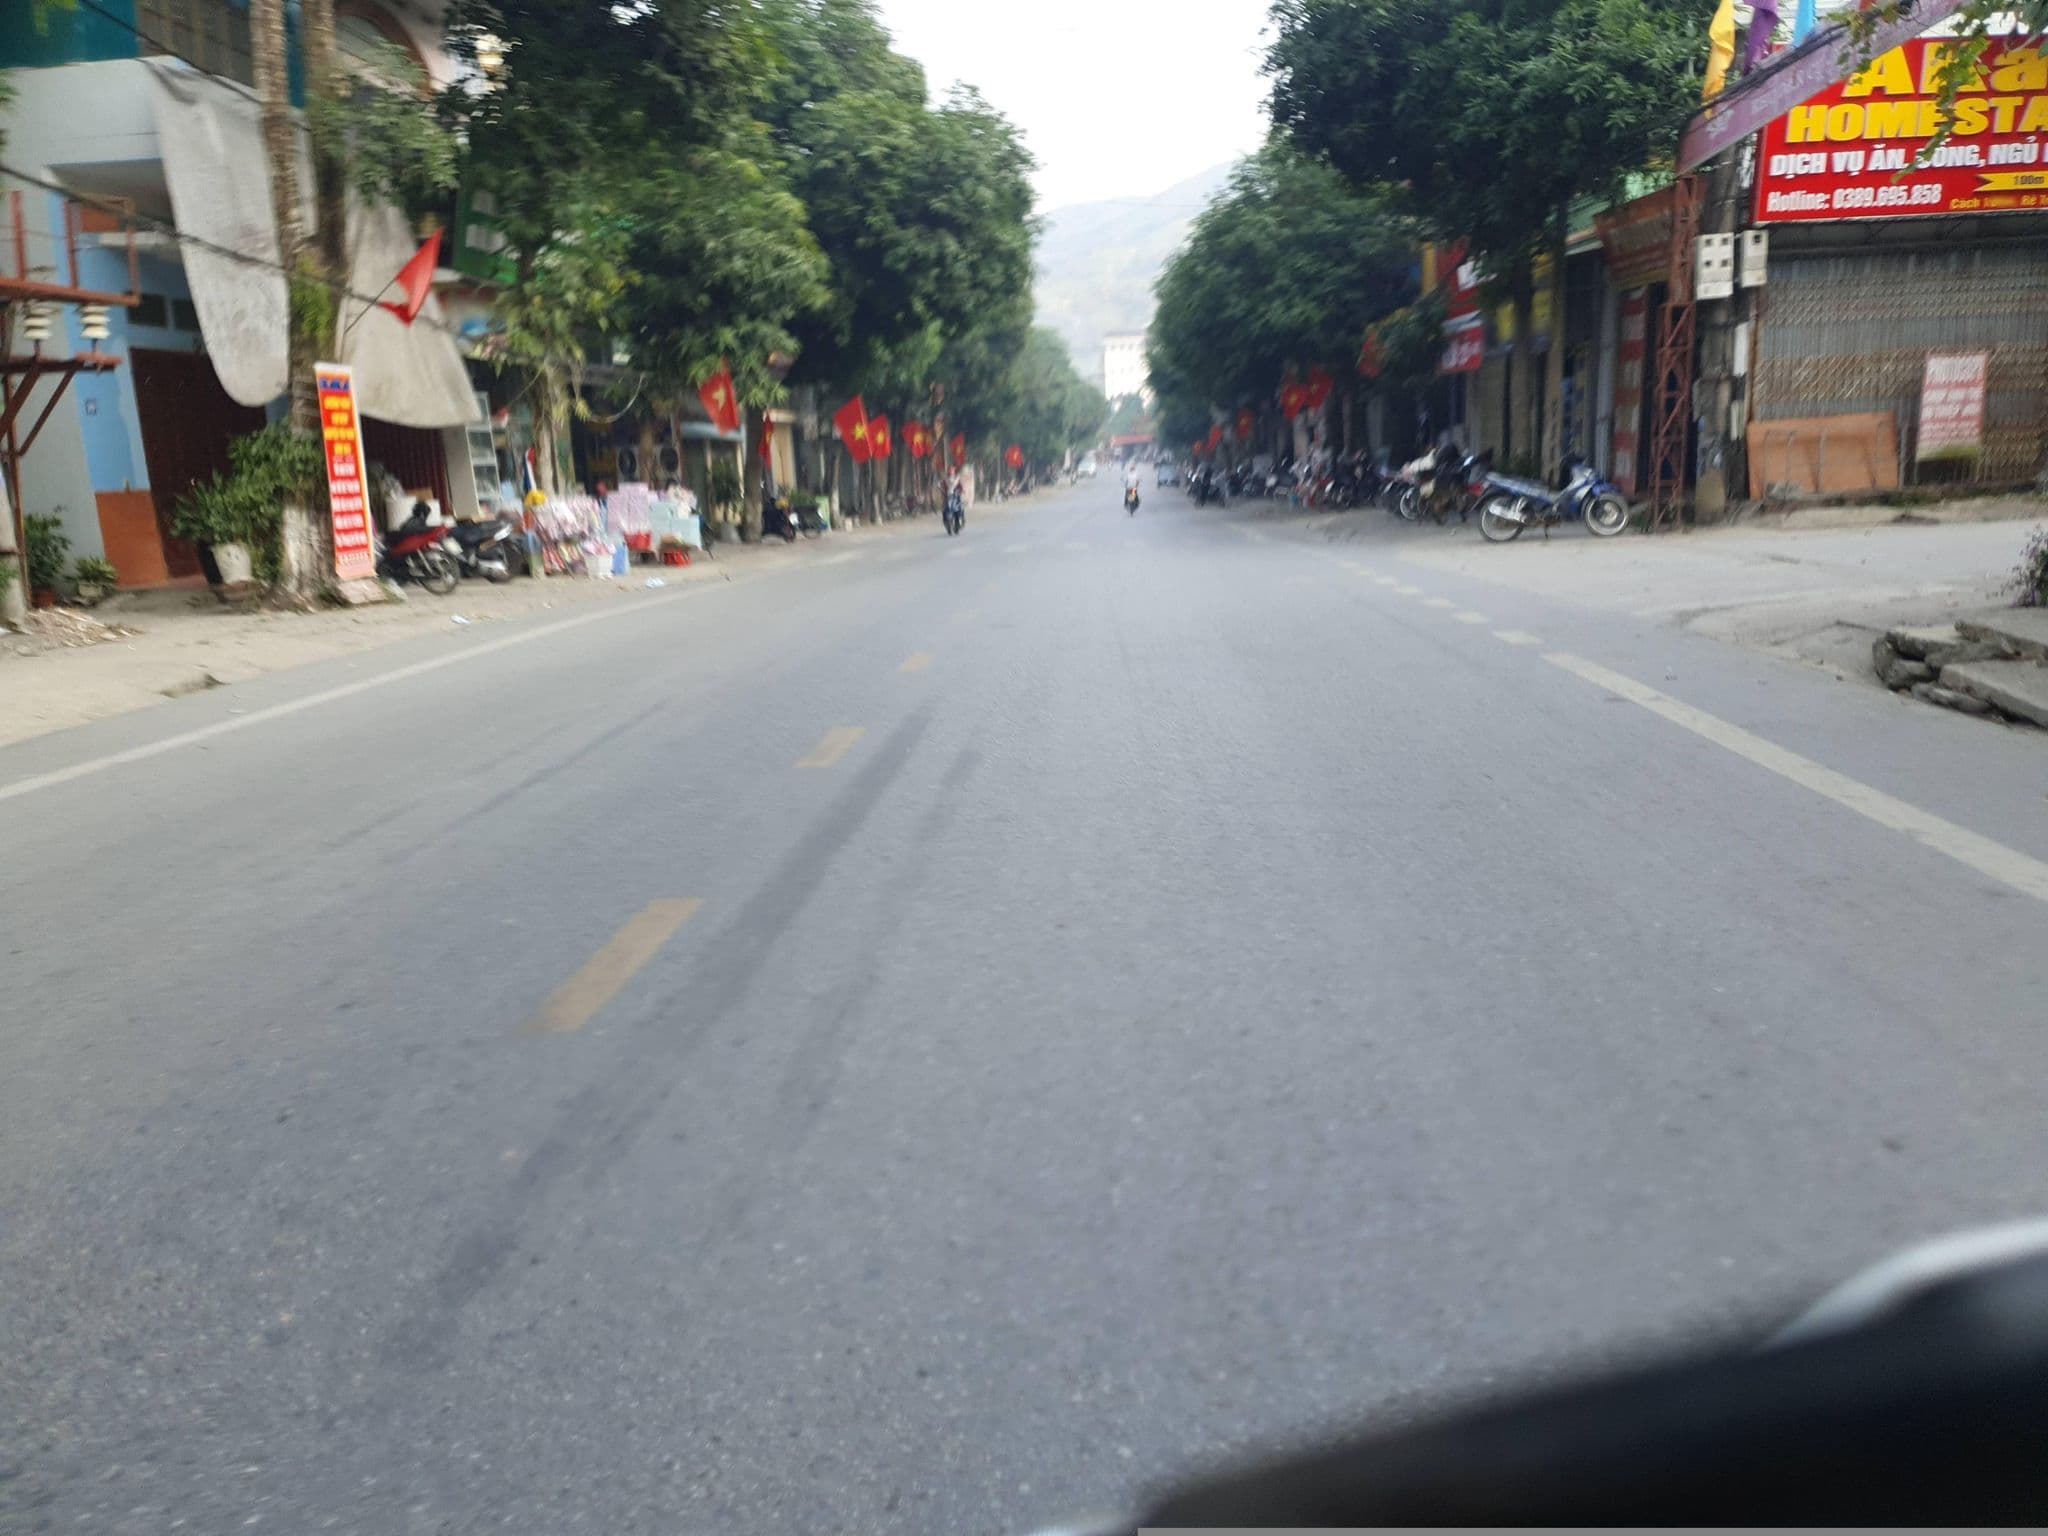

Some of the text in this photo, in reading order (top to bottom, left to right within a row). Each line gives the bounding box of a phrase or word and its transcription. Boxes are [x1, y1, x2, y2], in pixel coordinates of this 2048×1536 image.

[1769, 152, 1827, 179] DỊCH
[1832, 150, 1865, 176] VỤ
[1987, 136, 2039, 166] NGỦ
[1767, 189, 1830, 212] Hotline:
